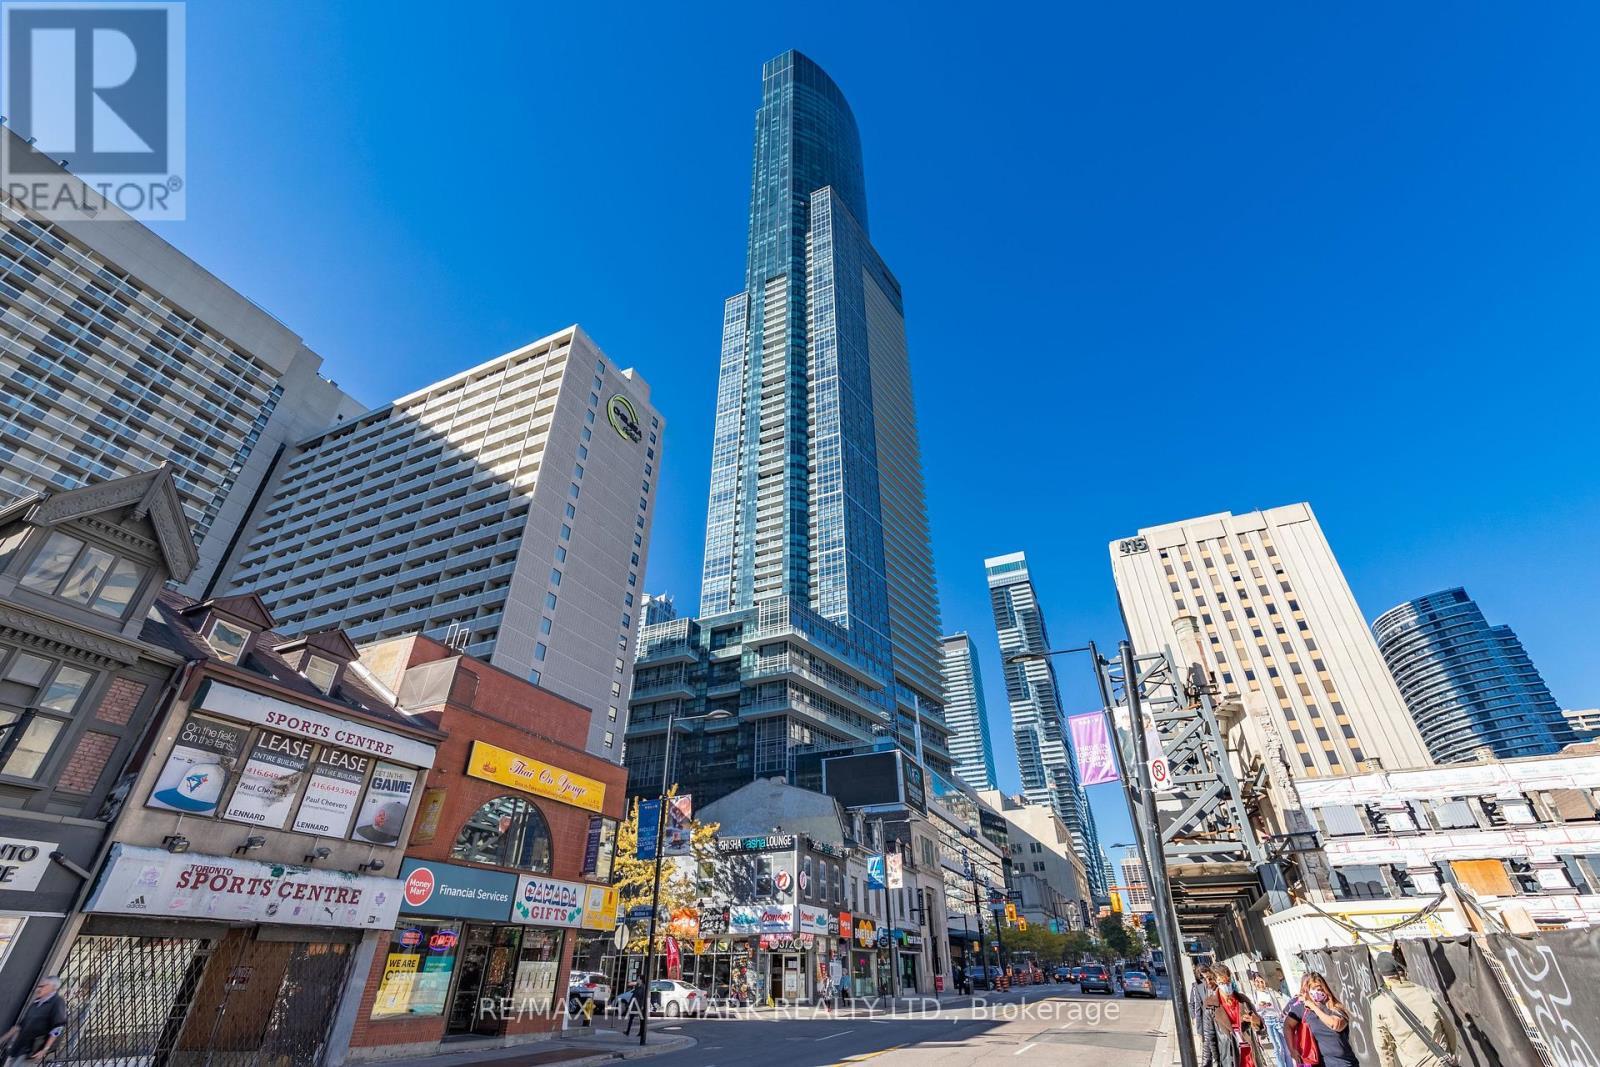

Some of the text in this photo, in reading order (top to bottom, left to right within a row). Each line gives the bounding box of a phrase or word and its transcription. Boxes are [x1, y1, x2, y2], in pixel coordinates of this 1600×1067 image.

[1119, 538, 1148, 554] 415
[181, 730, 198, 743] On
[198, 734, 214, 746] the
[185, 722, 237, 743] On the field.
[265, 711, 394, 756] SPORTS CENTRE
[257, 731, 312, 760] LEASE
[252, 751, 305, 770] ENTIRE BUILDING
[319, 748, 368, 773] LEASE
[316, 767, 362, 783] ENTIRE BUILDING
[509, 760, 535, 778] Thai
[538, 769, 553, 785] On
[557, 774, 587, 798] Yonge
[239, 782, 256, 791] Paul
[371, 777, 412, 794] GAME
[305, 796, 320, 804] Paul
[320, 798, 348, 810] Cheevers
[227, 809, 266, 822] LENNARD
[296, 820, 329, 832] LENNARD
[719, 839, 742, 851] SHISHA
[766, 835, 792, 847] LOUNGE
[190, 864, 234, 876] TORONTO
[176, 871, 362, 905] SPORTS CENTRE
[409, 878, 431, 890] Money
[409, 886, 426, 896] Mart
[439, 884, 509, 902] Financial Services
[524, 880, 577, 908] CANADA
[531, 905, 568, 921] GIFTS
[429, 935, 458, 947] OPEN
[779, 940, 794, 949] 372
[389, 959, 416, 968] WE ARE
[385, 970, 414, 981] OPEN
